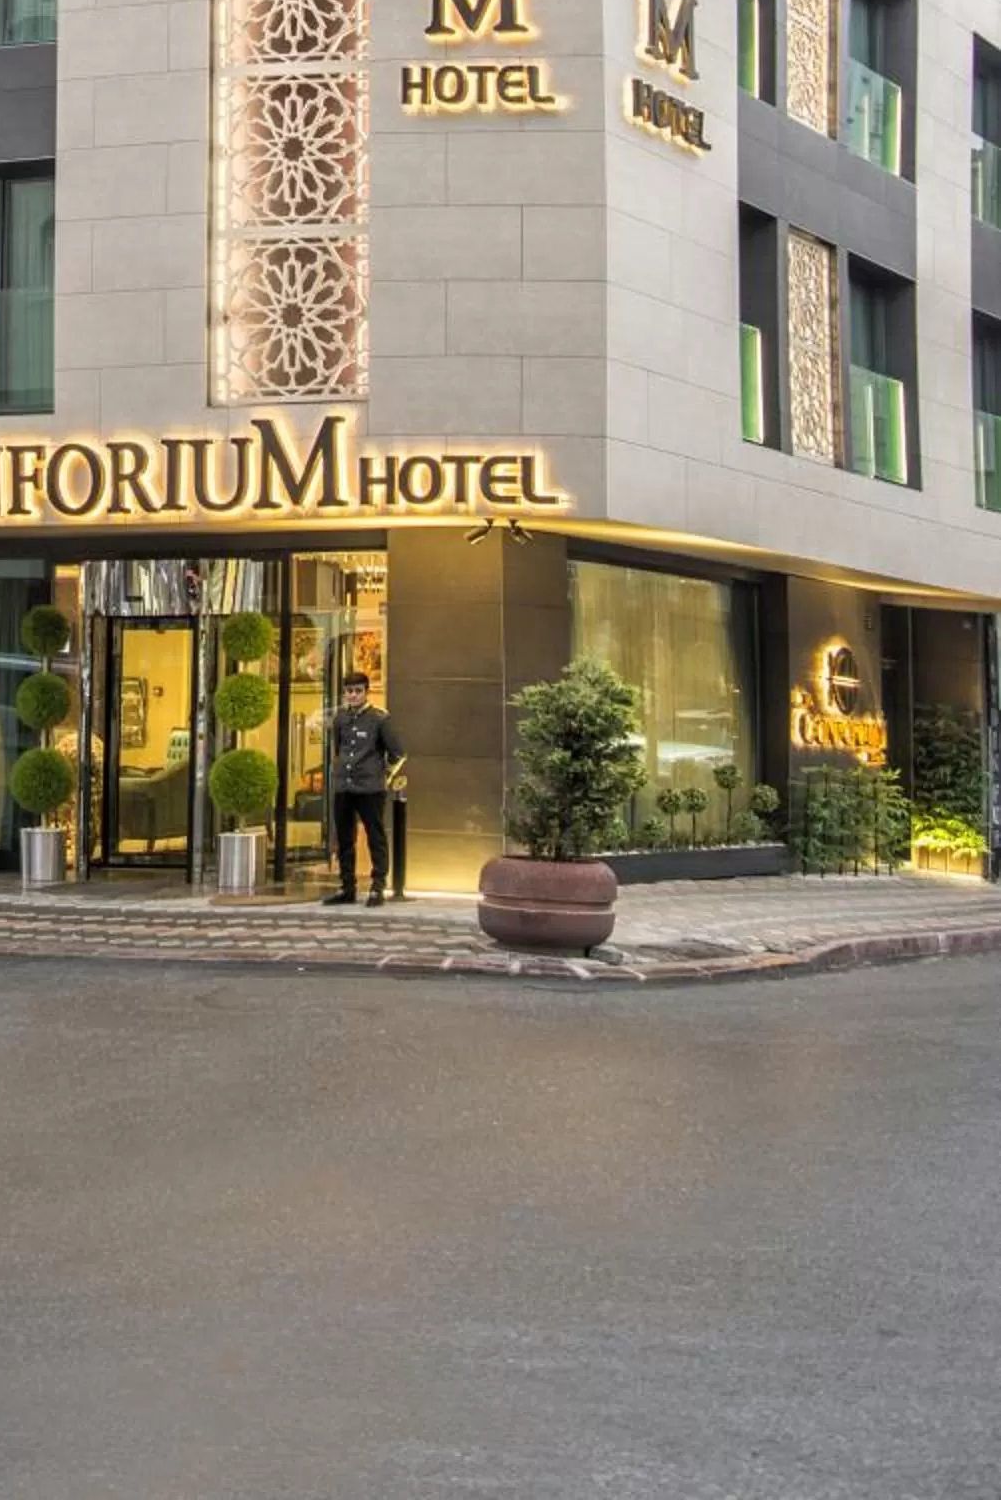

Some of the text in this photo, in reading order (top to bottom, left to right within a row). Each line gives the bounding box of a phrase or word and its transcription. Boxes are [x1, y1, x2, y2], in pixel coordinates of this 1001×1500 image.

[401, 65, 556, 105] HOTEL
[632, 78, 712, 151] HOTEL
[359, 455, 560, 505] HOTEL
